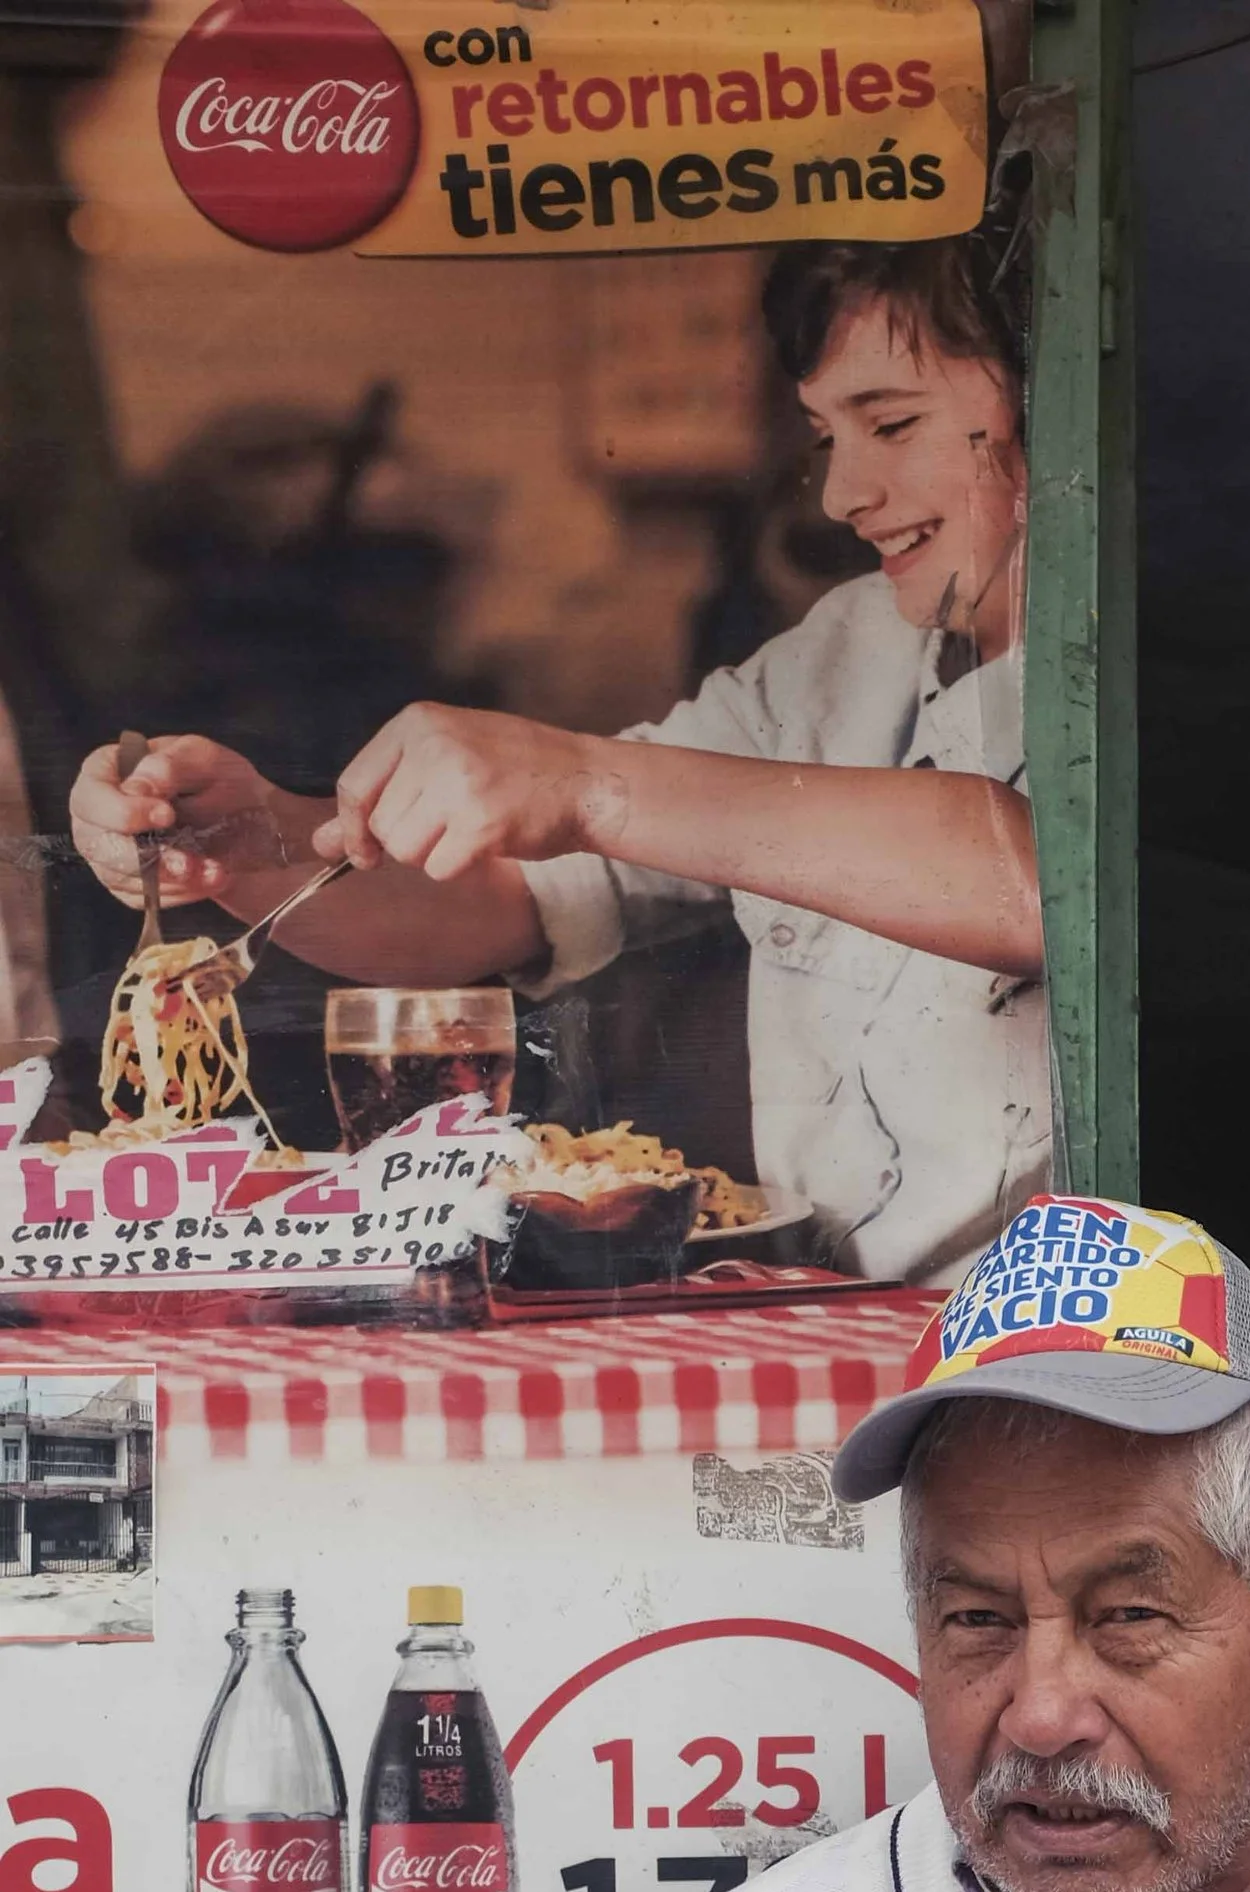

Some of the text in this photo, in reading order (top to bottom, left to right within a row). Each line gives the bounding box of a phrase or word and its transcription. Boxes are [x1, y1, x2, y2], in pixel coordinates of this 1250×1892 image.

[423, 21, 532, 69] con
[176, 77, 400, 154] Coca-Cola
[451, 48, 935, 140] retornables
[440, 138, 946, 239] tienes más
[115, 1219, 164, 1243] 45
[176, 1216, 229, 1239] Bis
[974, 1206, 1128, 1272] AREN
[973, 1240, 1140, 1292] PARTIDO
[983, 1266, 1119, 1304] SIENTO
[943, 1285, 1108, 1361] VACÍO
[1122, 1328, 1188, 1351] AGUILA
[1122, 1340, 1178, 1361] ORIGINAL
[415, 1745, 463, 1757] LITROS
[592, 1736, 821, 1830] 1.25
[206, 1837, 330, 1884] Coca-Cola
[376, 1844, 500, 1890] Coca-Cola
